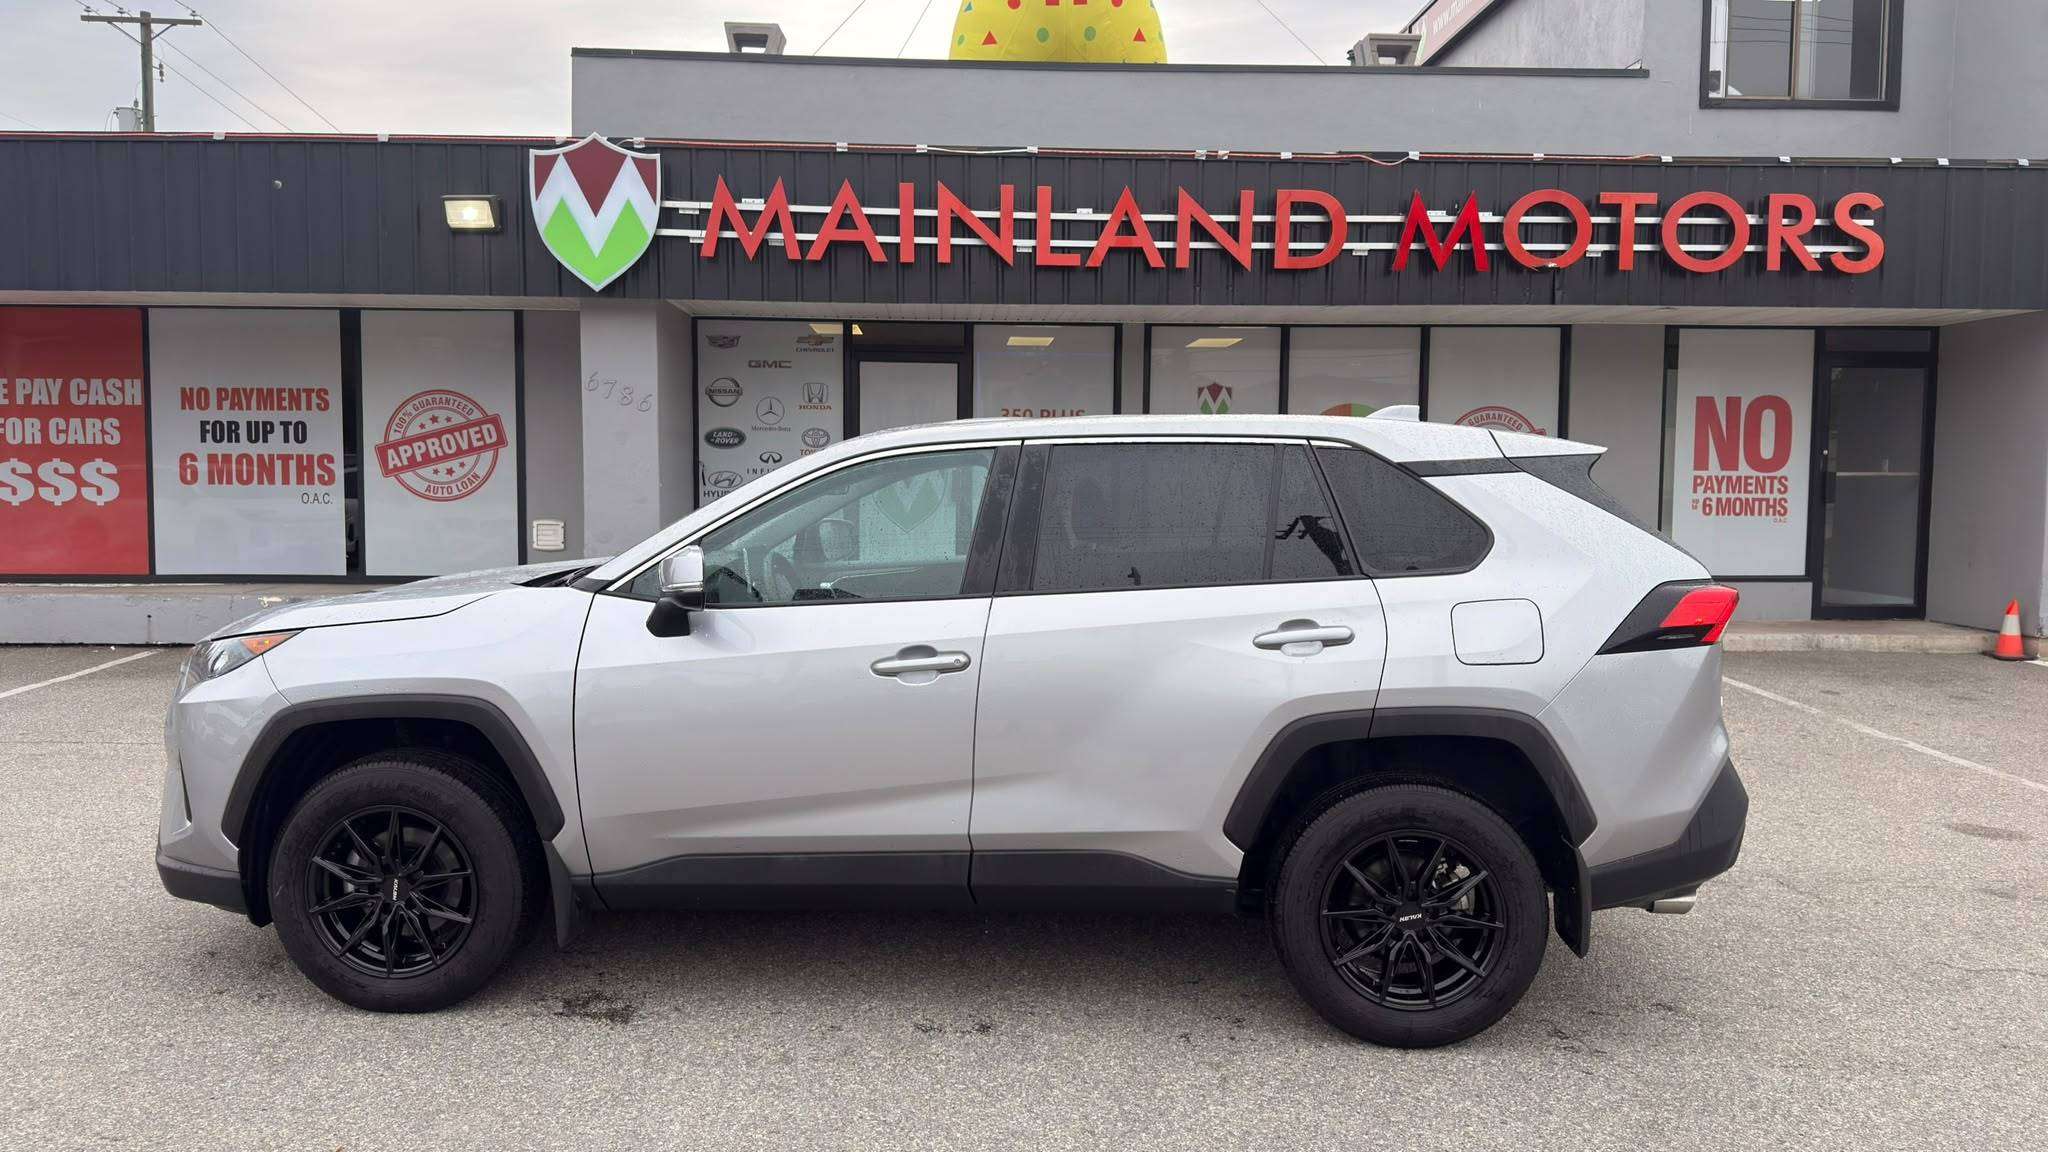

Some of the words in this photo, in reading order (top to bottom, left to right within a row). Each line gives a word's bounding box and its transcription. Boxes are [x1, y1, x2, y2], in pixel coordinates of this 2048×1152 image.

[700, 173, 1348, 272] MAINLAND
[1391, 188, 1886, 274] MOTORS
[748, 359, 792, 369] GMC
[0, 378, 9, 405] E
[16, 378, 63, 405] PAY
[70, 378, 142, 406] CASH
[180, 387, 210, 411] NO
[216, 387, 330, 412] PAYMENTS
[585, 371, 653, 413] 6786
[412, 397, 475, 416] GUARANTEED
[49, 417, 120, 445] CARS
[200, 420, 240, 444] FOR
[246, 420, 275, 444] UP
[280, 420, 307, 444] TO
[1467, 412, 1523, 432] GUARANTEED
[1693, 395, 1793, 473] NO
[386, 423, 498, 470] APPROVED
[179, 452, 199, 486] 6
[207, 453, 336, 486] MONTHS
[424, 484, 454, 496] AUTO
[457, 472, 481, 493] LOAN
[1692, 475, 1789, 495] PAYMENTS
[301, 492, 334, 505] O.A.C.
[1702, 497, 1713, 517] 6
[1715, 498, 1788, 517] MONTHS
